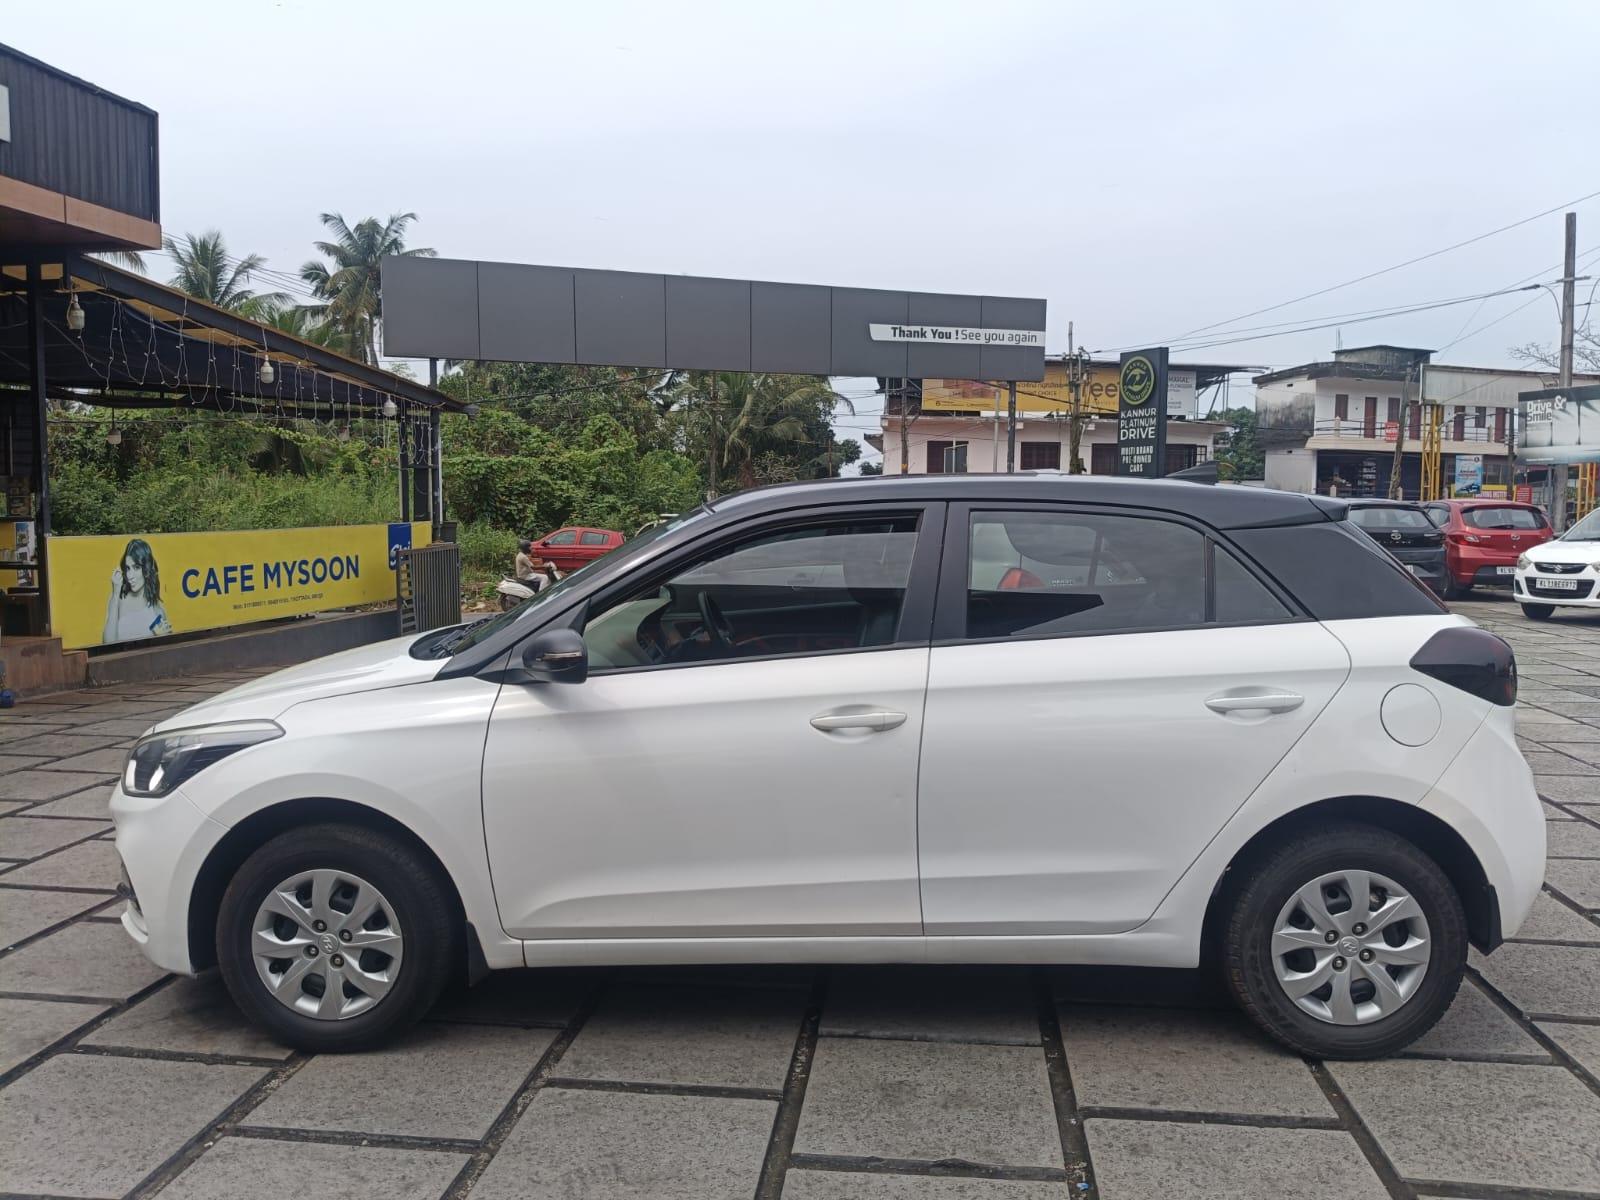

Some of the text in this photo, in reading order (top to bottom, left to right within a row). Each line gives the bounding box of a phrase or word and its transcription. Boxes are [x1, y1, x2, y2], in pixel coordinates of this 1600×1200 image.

[891, 326, 927, 339] Thank
[931, 328, 952, 340] You
[961, 329, 981, 341] See
[984, 332, 1004, 344] you
[1007, 331, 1037, 345] again
[1527, 395, 1567, 413] Drive &
[1120, 407, 1157, 419] KANNUR
[1527, 411, 1553, 423] Smile
[1120, 417, 1157, 428] PLATINUM
[1120, 426, 1156, 440] DRIVE
[1129, 463, 1143, 473] CARS
[181, 564, 255, 599] CAFE
[263, 554, 360, 589] MYSOON
